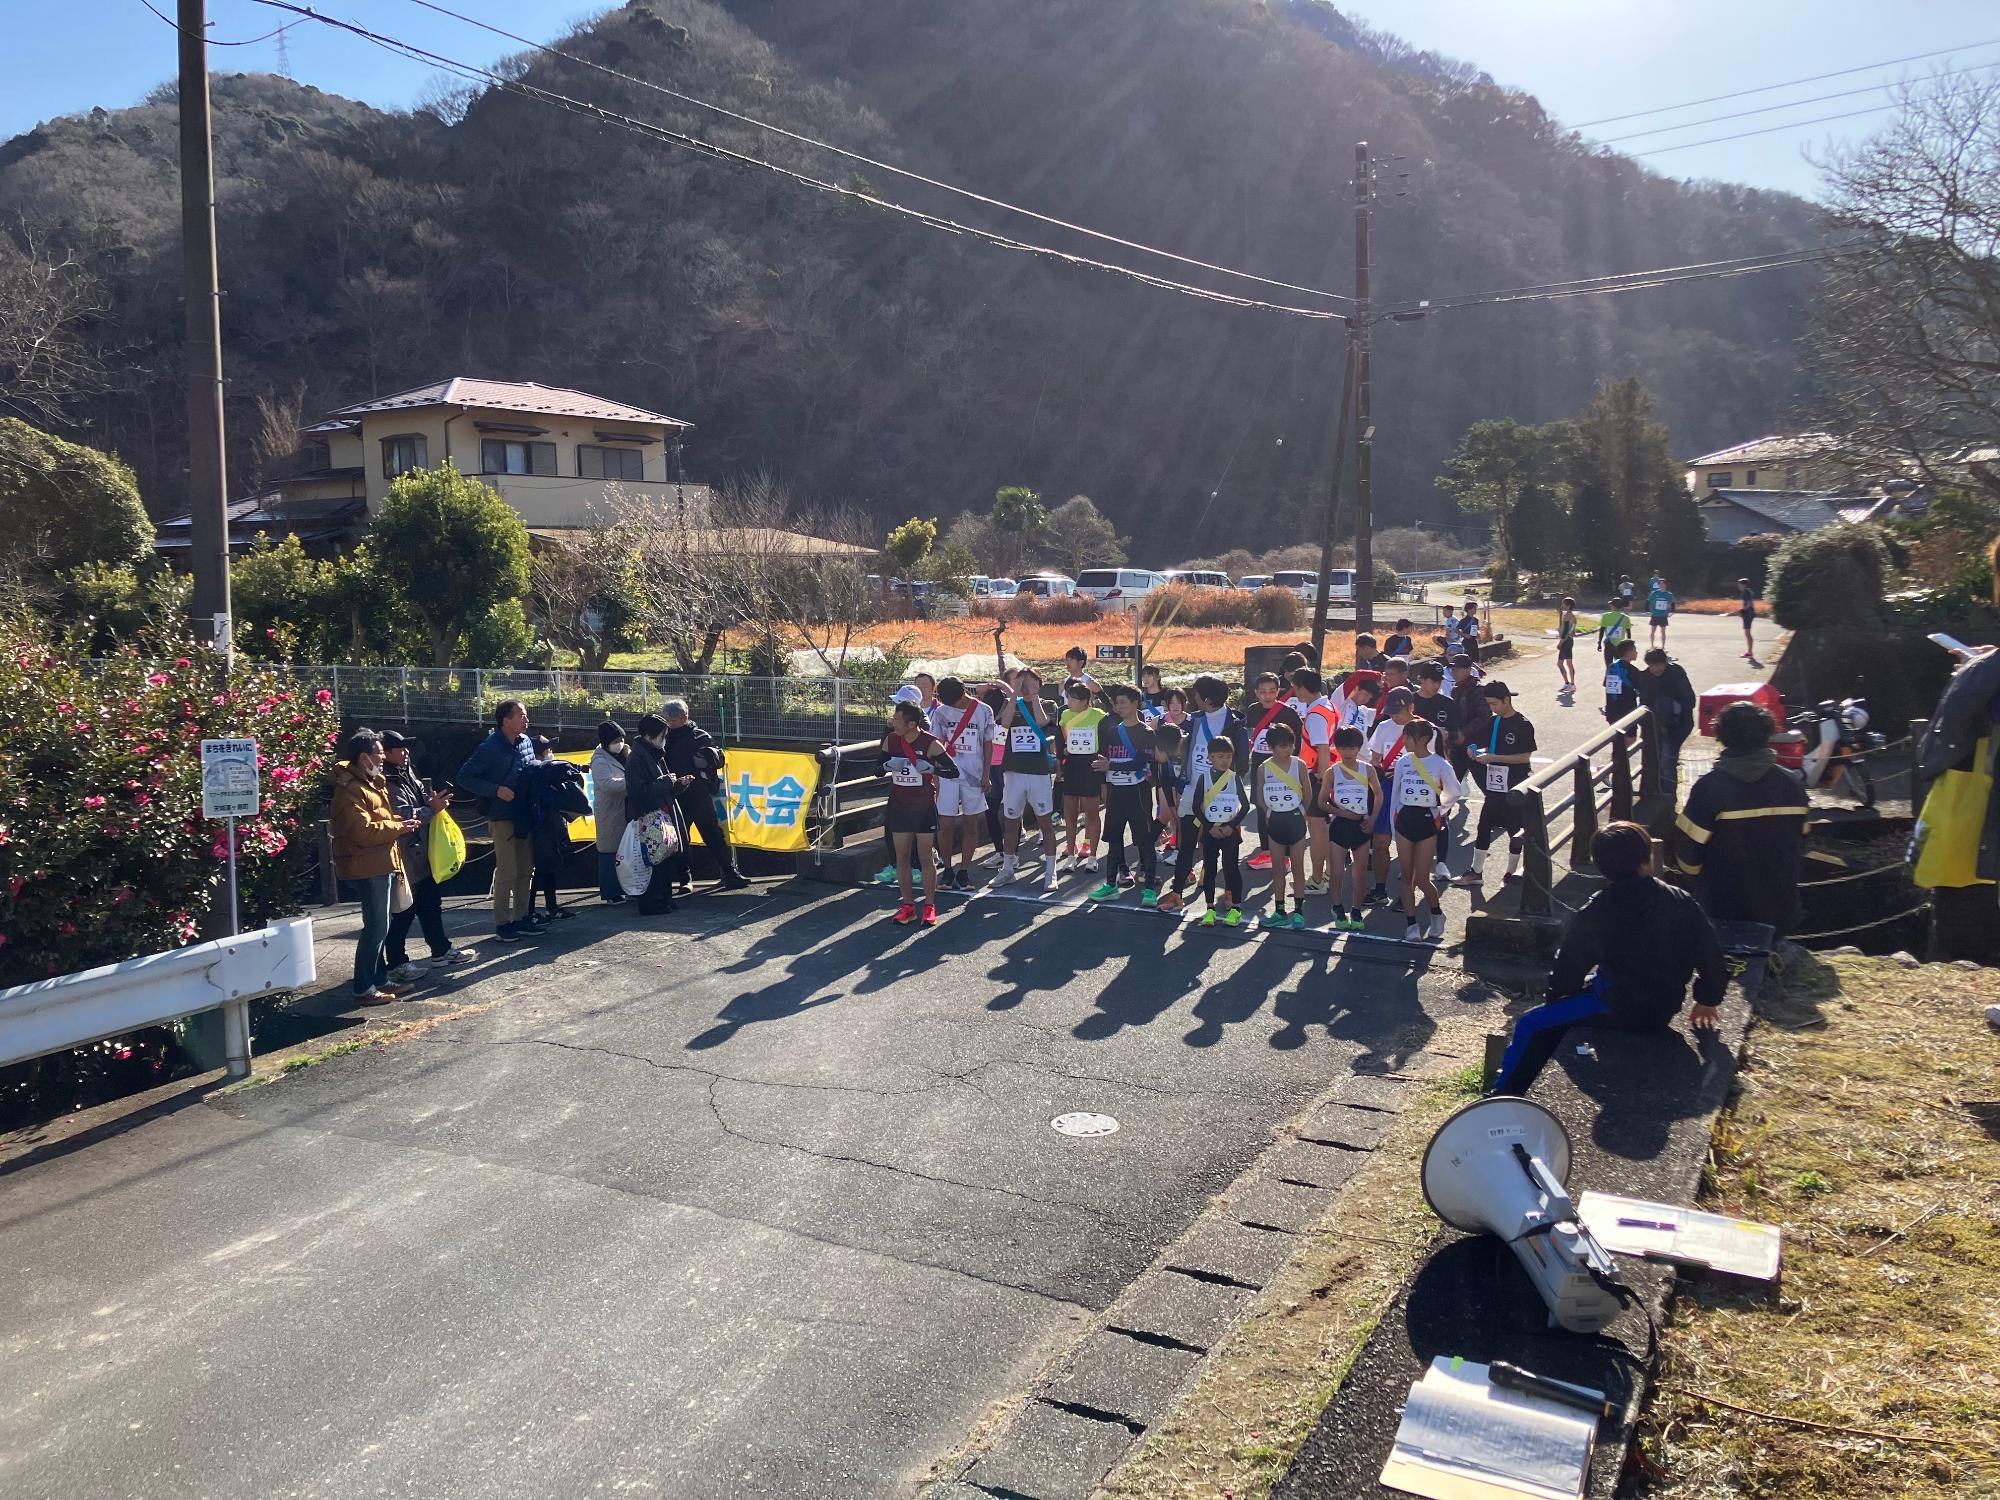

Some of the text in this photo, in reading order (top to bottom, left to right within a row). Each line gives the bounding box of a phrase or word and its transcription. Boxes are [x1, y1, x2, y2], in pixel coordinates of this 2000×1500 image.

[959, 736, 965, 744] 1
[1015, 735, 1036, 744] 22
[205, 743, 253, 753] まちをきれいに
[900, 767, 911, 776] 8
[1489, 774, 1503, 784] 13
[1405, 787, 1430, 796] 69
[712, 773, 805, 826] 大会
[1269, 794, 1293, 802] 66
[1340, 797, 1364, 805] 67
[1209, 805, 1233, 813] 68
